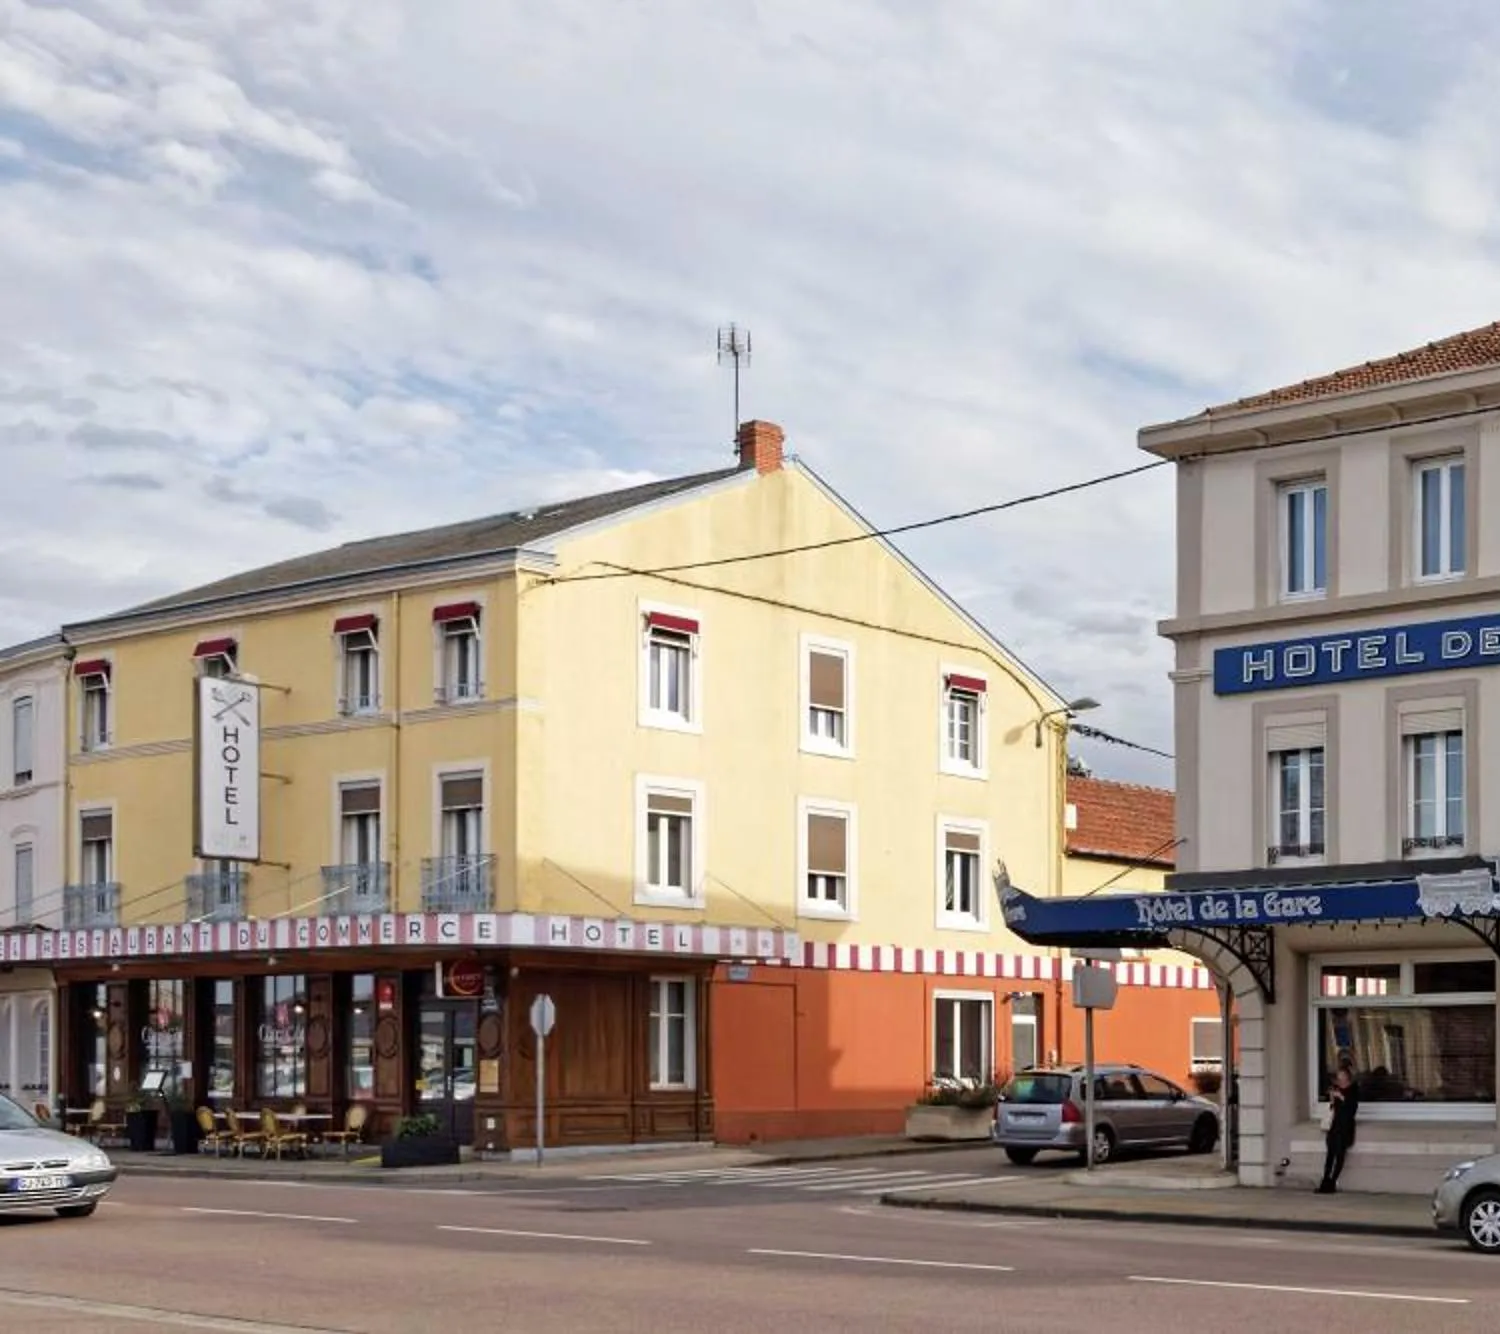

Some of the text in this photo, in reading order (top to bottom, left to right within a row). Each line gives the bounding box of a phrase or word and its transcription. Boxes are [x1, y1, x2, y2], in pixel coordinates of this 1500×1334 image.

[1242, 632, 1425, 683] HOTEL
[221, 726, 241, 825] HOTEL
[1134, 892, 1323, 926] Hôtel de la Gare
[43, 931, 211, 953] RESTAURANT
[239, 927, 267, 945] DU
[299, 921, 492, 941] COMMERCE
[551, 923, 688, 947] HOTEL
